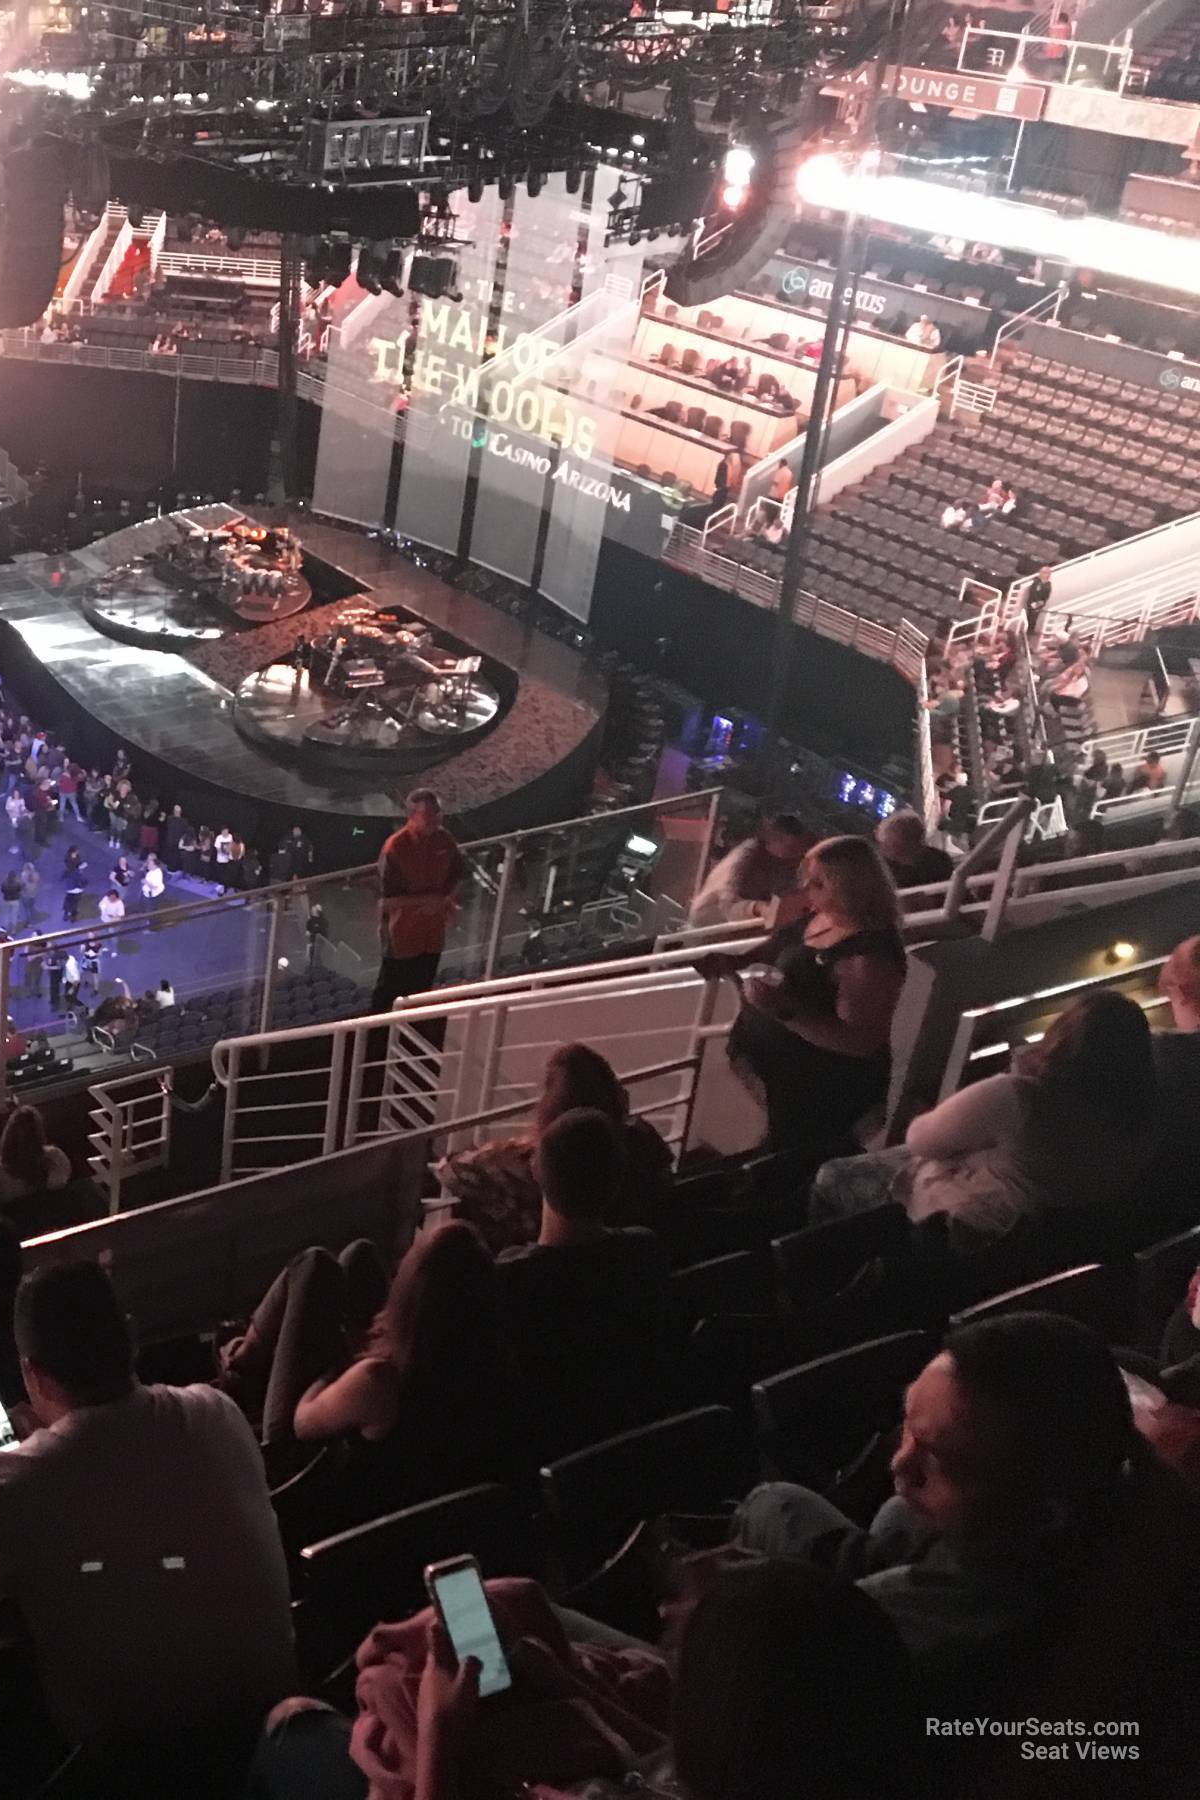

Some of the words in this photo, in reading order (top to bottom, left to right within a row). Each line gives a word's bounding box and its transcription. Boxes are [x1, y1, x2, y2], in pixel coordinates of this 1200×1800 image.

[808, 278, 888, 314] anexus
[418, 298, 508, 358] MAN
[512, 331, 562, 381] OF
[453, 362, 598, 461] WOODS
[551, 460, 631, 513] ARIZONA
